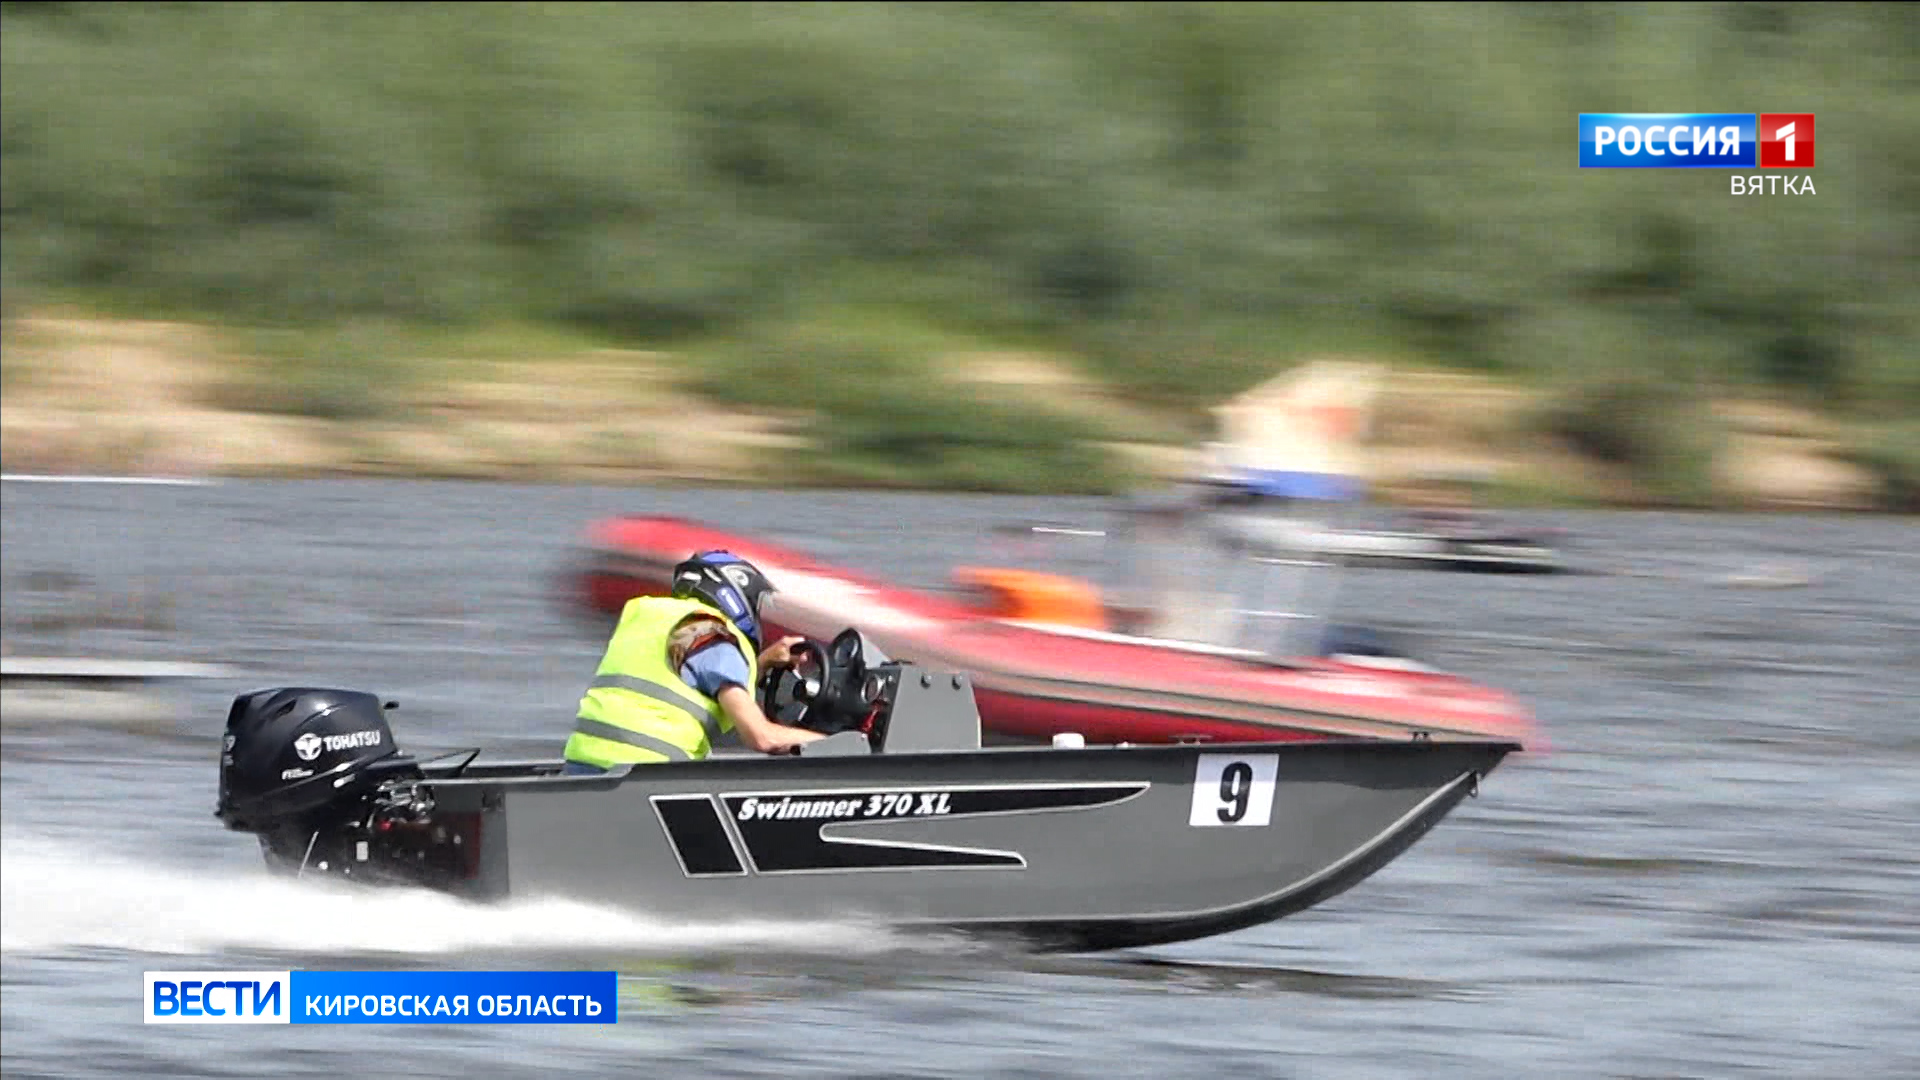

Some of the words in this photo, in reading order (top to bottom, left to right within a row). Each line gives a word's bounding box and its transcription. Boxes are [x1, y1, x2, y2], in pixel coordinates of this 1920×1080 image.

[323, 731, 381, 752] TOHATSU
[1217, 761, 1253, 824] 9
[738, 797, 862, 820] Swimmer
[863, 793, 913, 816] 370
[914, 793, 951, 814] XL
